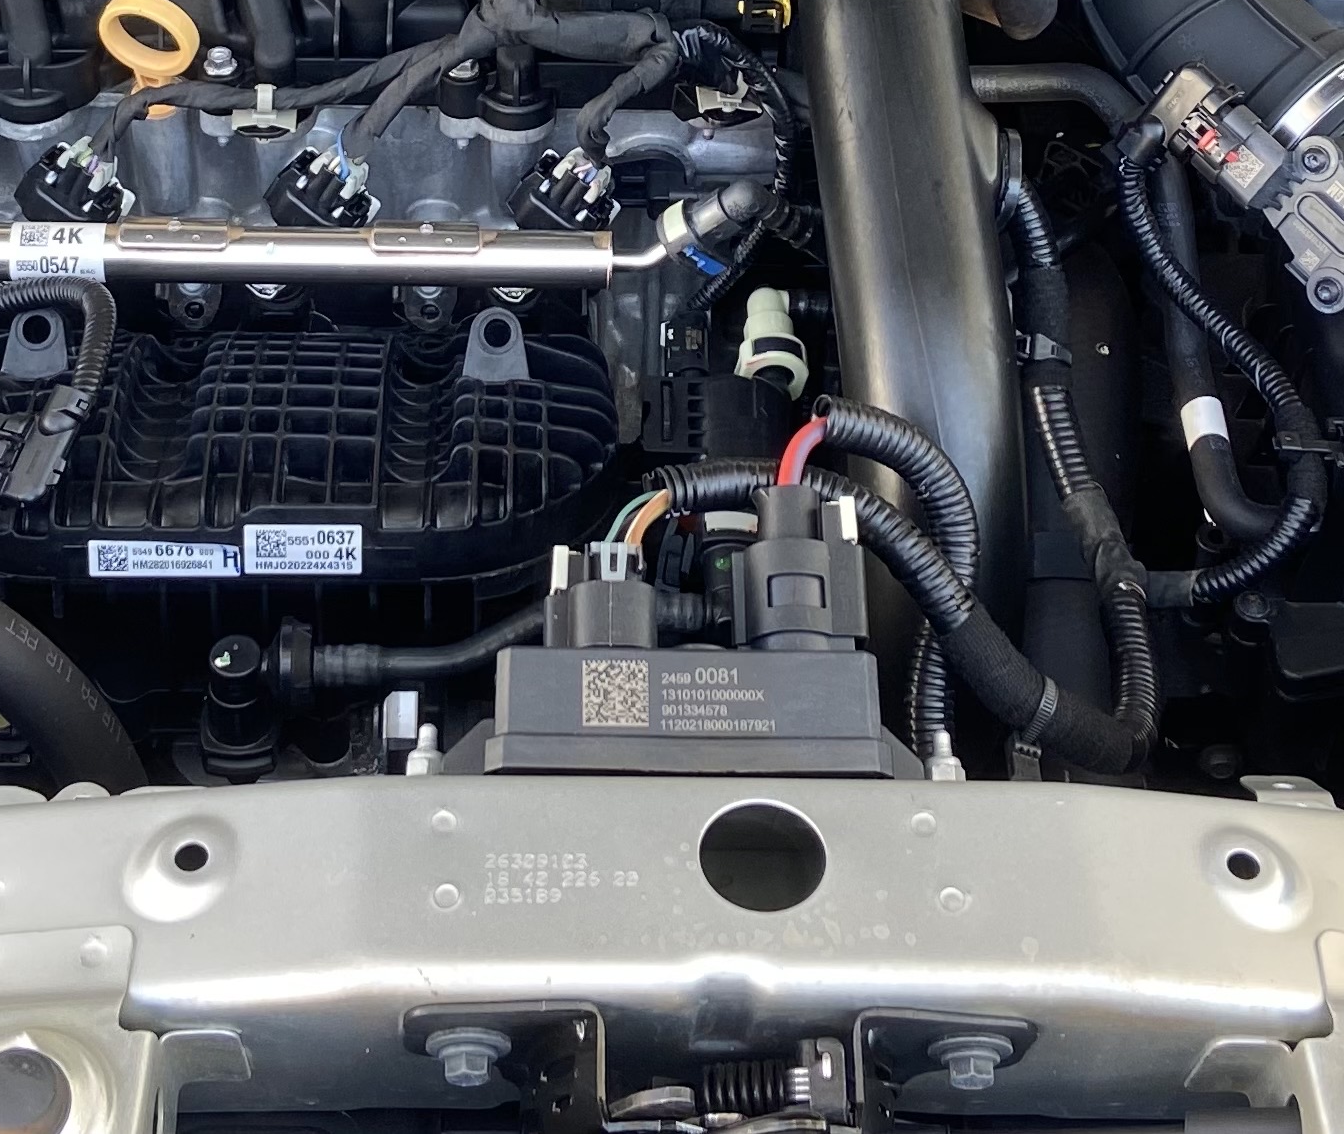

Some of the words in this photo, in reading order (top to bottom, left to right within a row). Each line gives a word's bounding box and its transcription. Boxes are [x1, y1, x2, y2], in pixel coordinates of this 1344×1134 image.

[51, 227, 84, 244] 4K
[16, 259, 38, 272] 5550
[39, 256, 80, 274] 0547
[287, 536, 316, 546] 5551
[317, 530, 355, 545] 0637
[155, 545, 195, 557] 6676
[305, 550, 330, 560] 000
[333, 547, 357, 560] 4K
[5, 618, 39, 652] PET
[694, 667, 739, 685] 0081
